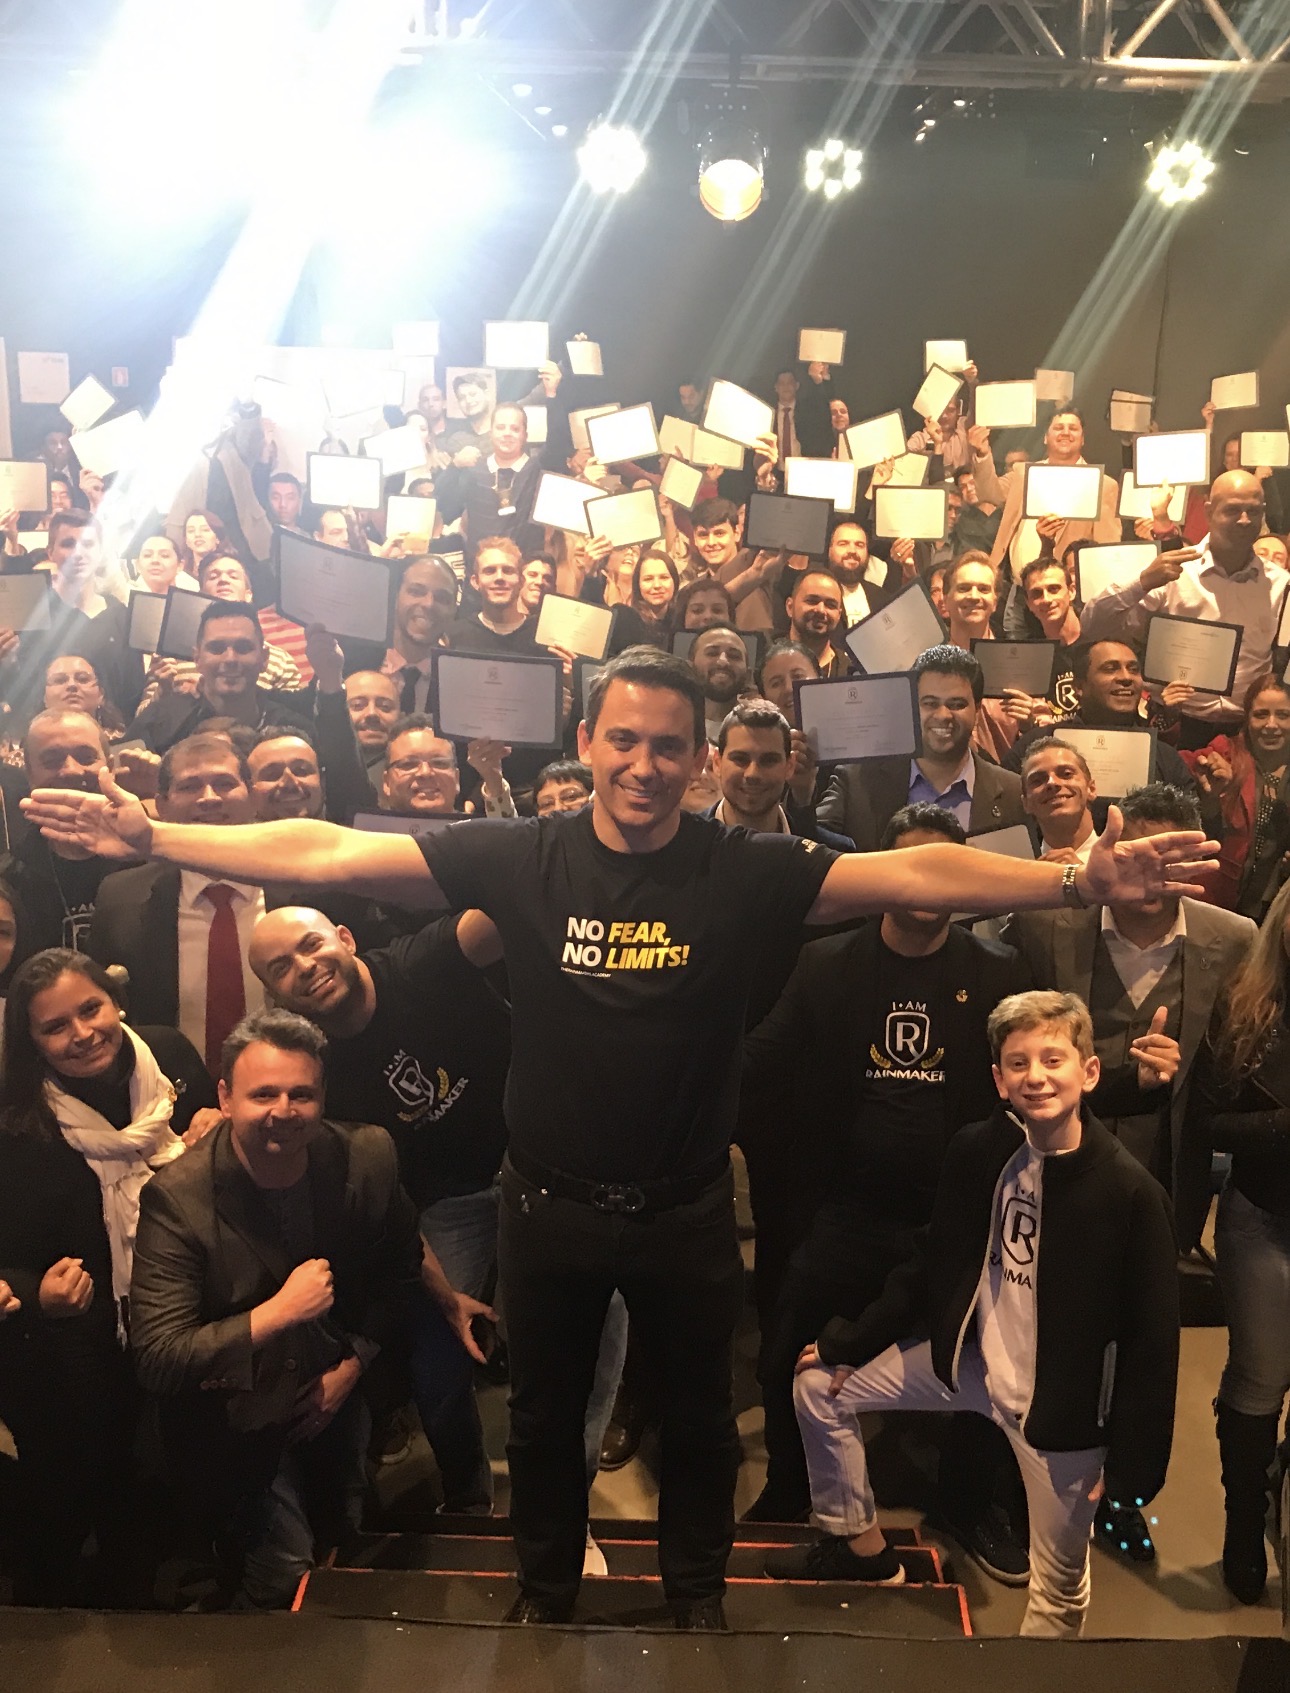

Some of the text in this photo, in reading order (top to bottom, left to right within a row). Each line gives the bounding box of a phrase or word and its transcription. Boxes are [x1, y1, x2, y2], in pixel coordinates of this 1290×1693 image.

[1061, 684, 1079, 703] R
[566, 916, 672, 945] NO FEAR,
[562, 942, 690, 969] NO LIMITS!
[896, 1021, 921, 1058] R
[1010, 1210, 1037, 1260] R
